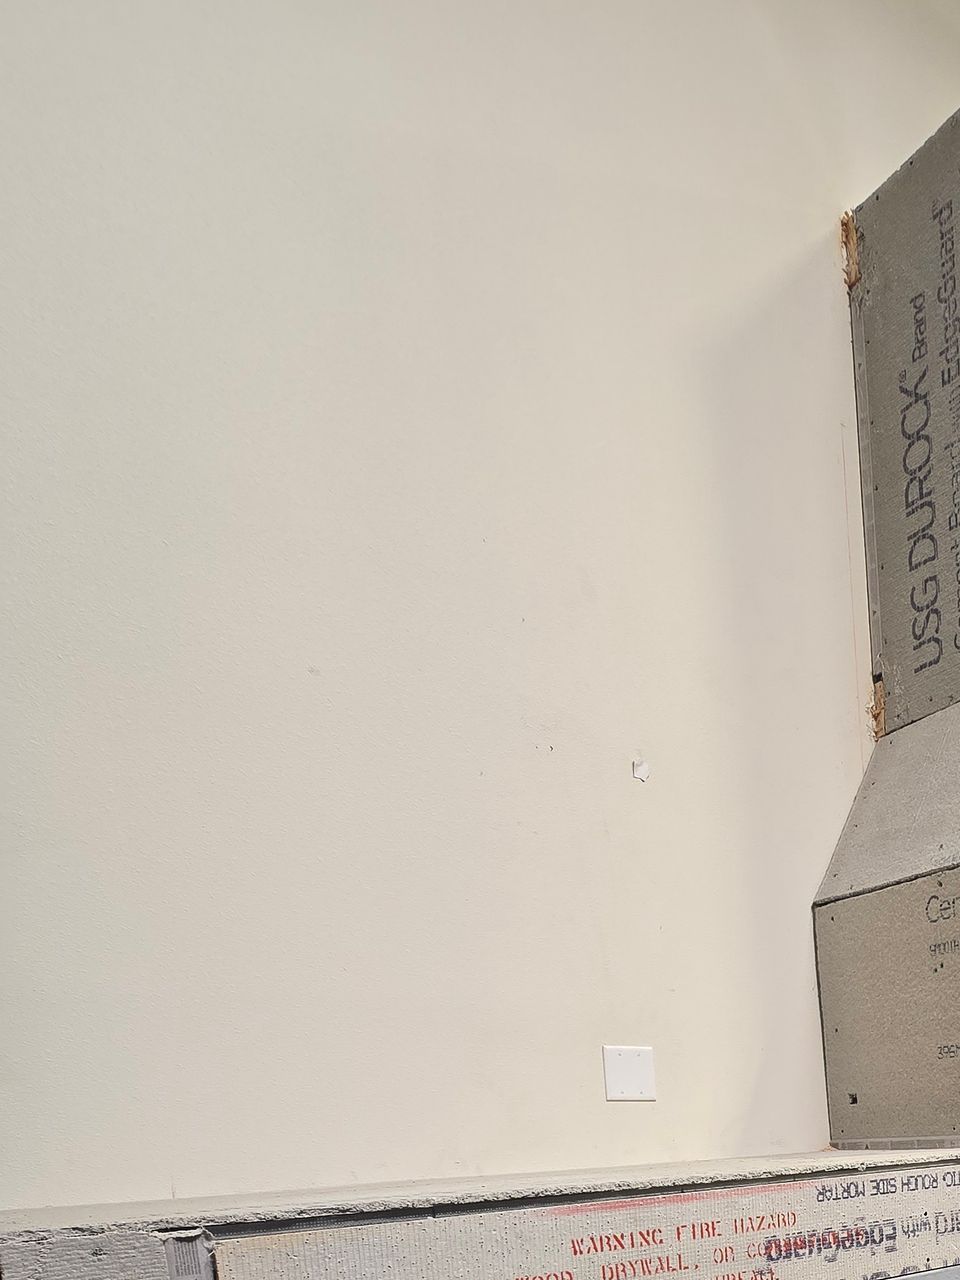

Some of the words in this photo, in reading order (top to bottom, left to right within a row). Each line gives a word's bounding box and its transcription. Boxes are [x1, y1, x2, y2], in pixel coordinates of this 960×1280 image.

[910, 291, 928, 362] Brand
[911, 575, 943, 674] USG
[816, 1179, 866, 1203] MORTAR
[869, 1176, 897, 1196] SIDE
[901, 1173, 939, 1191] ROUGH
[571, 1228, 664, 1256] WARNING
[676, 1220, 722, 1242] FIRE
[734, 1211, 800, 1234] HAZARD
[713, 1246, 736, 1265] OR
